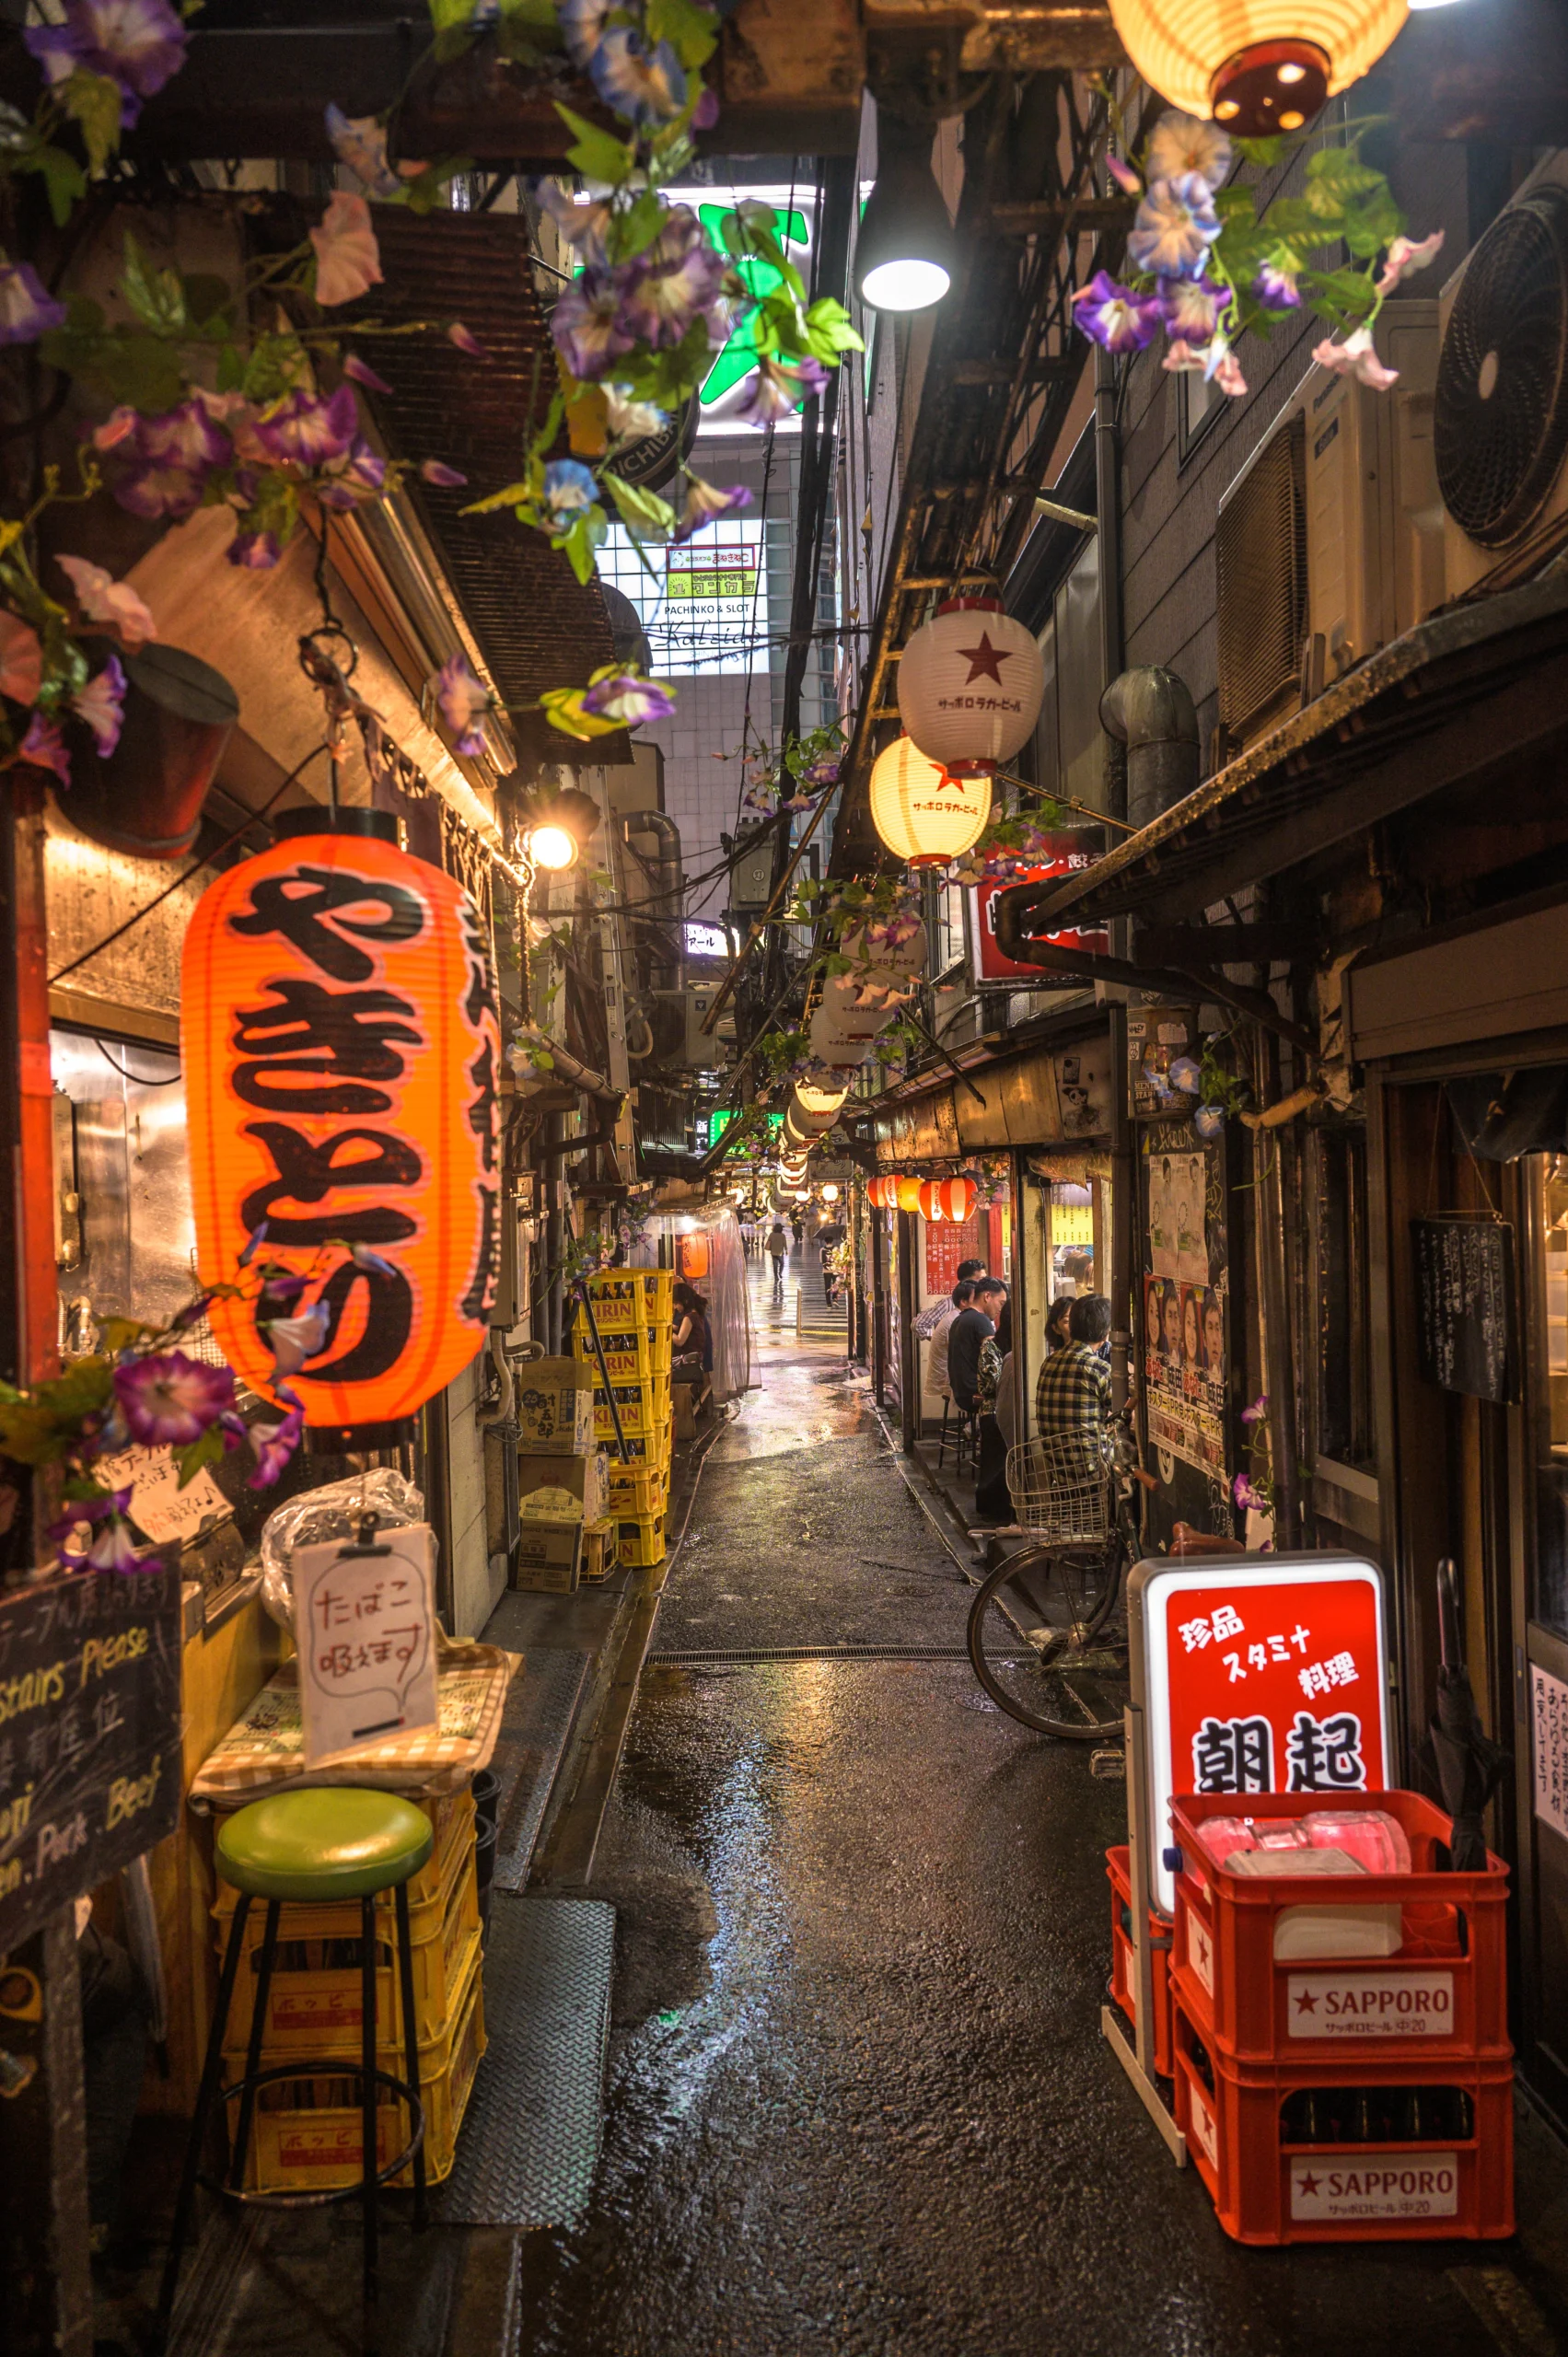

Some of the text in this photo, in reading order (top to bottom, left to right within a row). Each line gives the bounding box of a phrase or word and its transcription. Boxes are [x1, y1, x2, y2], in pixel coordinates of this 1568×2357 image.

[713, 553, 749, 563] まねきねこ
[692, 580, 755, 594] ワンカラ
[665, 604, 749, 615] PACHINKO & SLOT
[938, 696, 1022, 713] サッポロラガービール
[912, 801, 979, 816] サッポロラガービール
[586, 1302, 632, 1318] IRIN
[588, 1355, 636, 1371] KRIN
[315, 1581, 412, 1631] たばこ
[1178, 1605, 1245, 1654] 珍品
[80, 1625, 150, 1689] Please
[319, 1621, 424, 1684] 吸えます
[1222, 1624, 1311, 1683] スタミナ
[1297, 1651, 1360, 1701] 料理
[1193, 1712, 1366, 1794] 朝起
[105, 1754, 163, 1832] Beef
[1325, 1989, 1449, 2015] SAPPORO
[1325, 2022, 1393, 2034] サッポロビール
[1328, 2169, 1454, 2198] SAPPORO
[1328, 2202, 1396, 2216] サッポロビール
